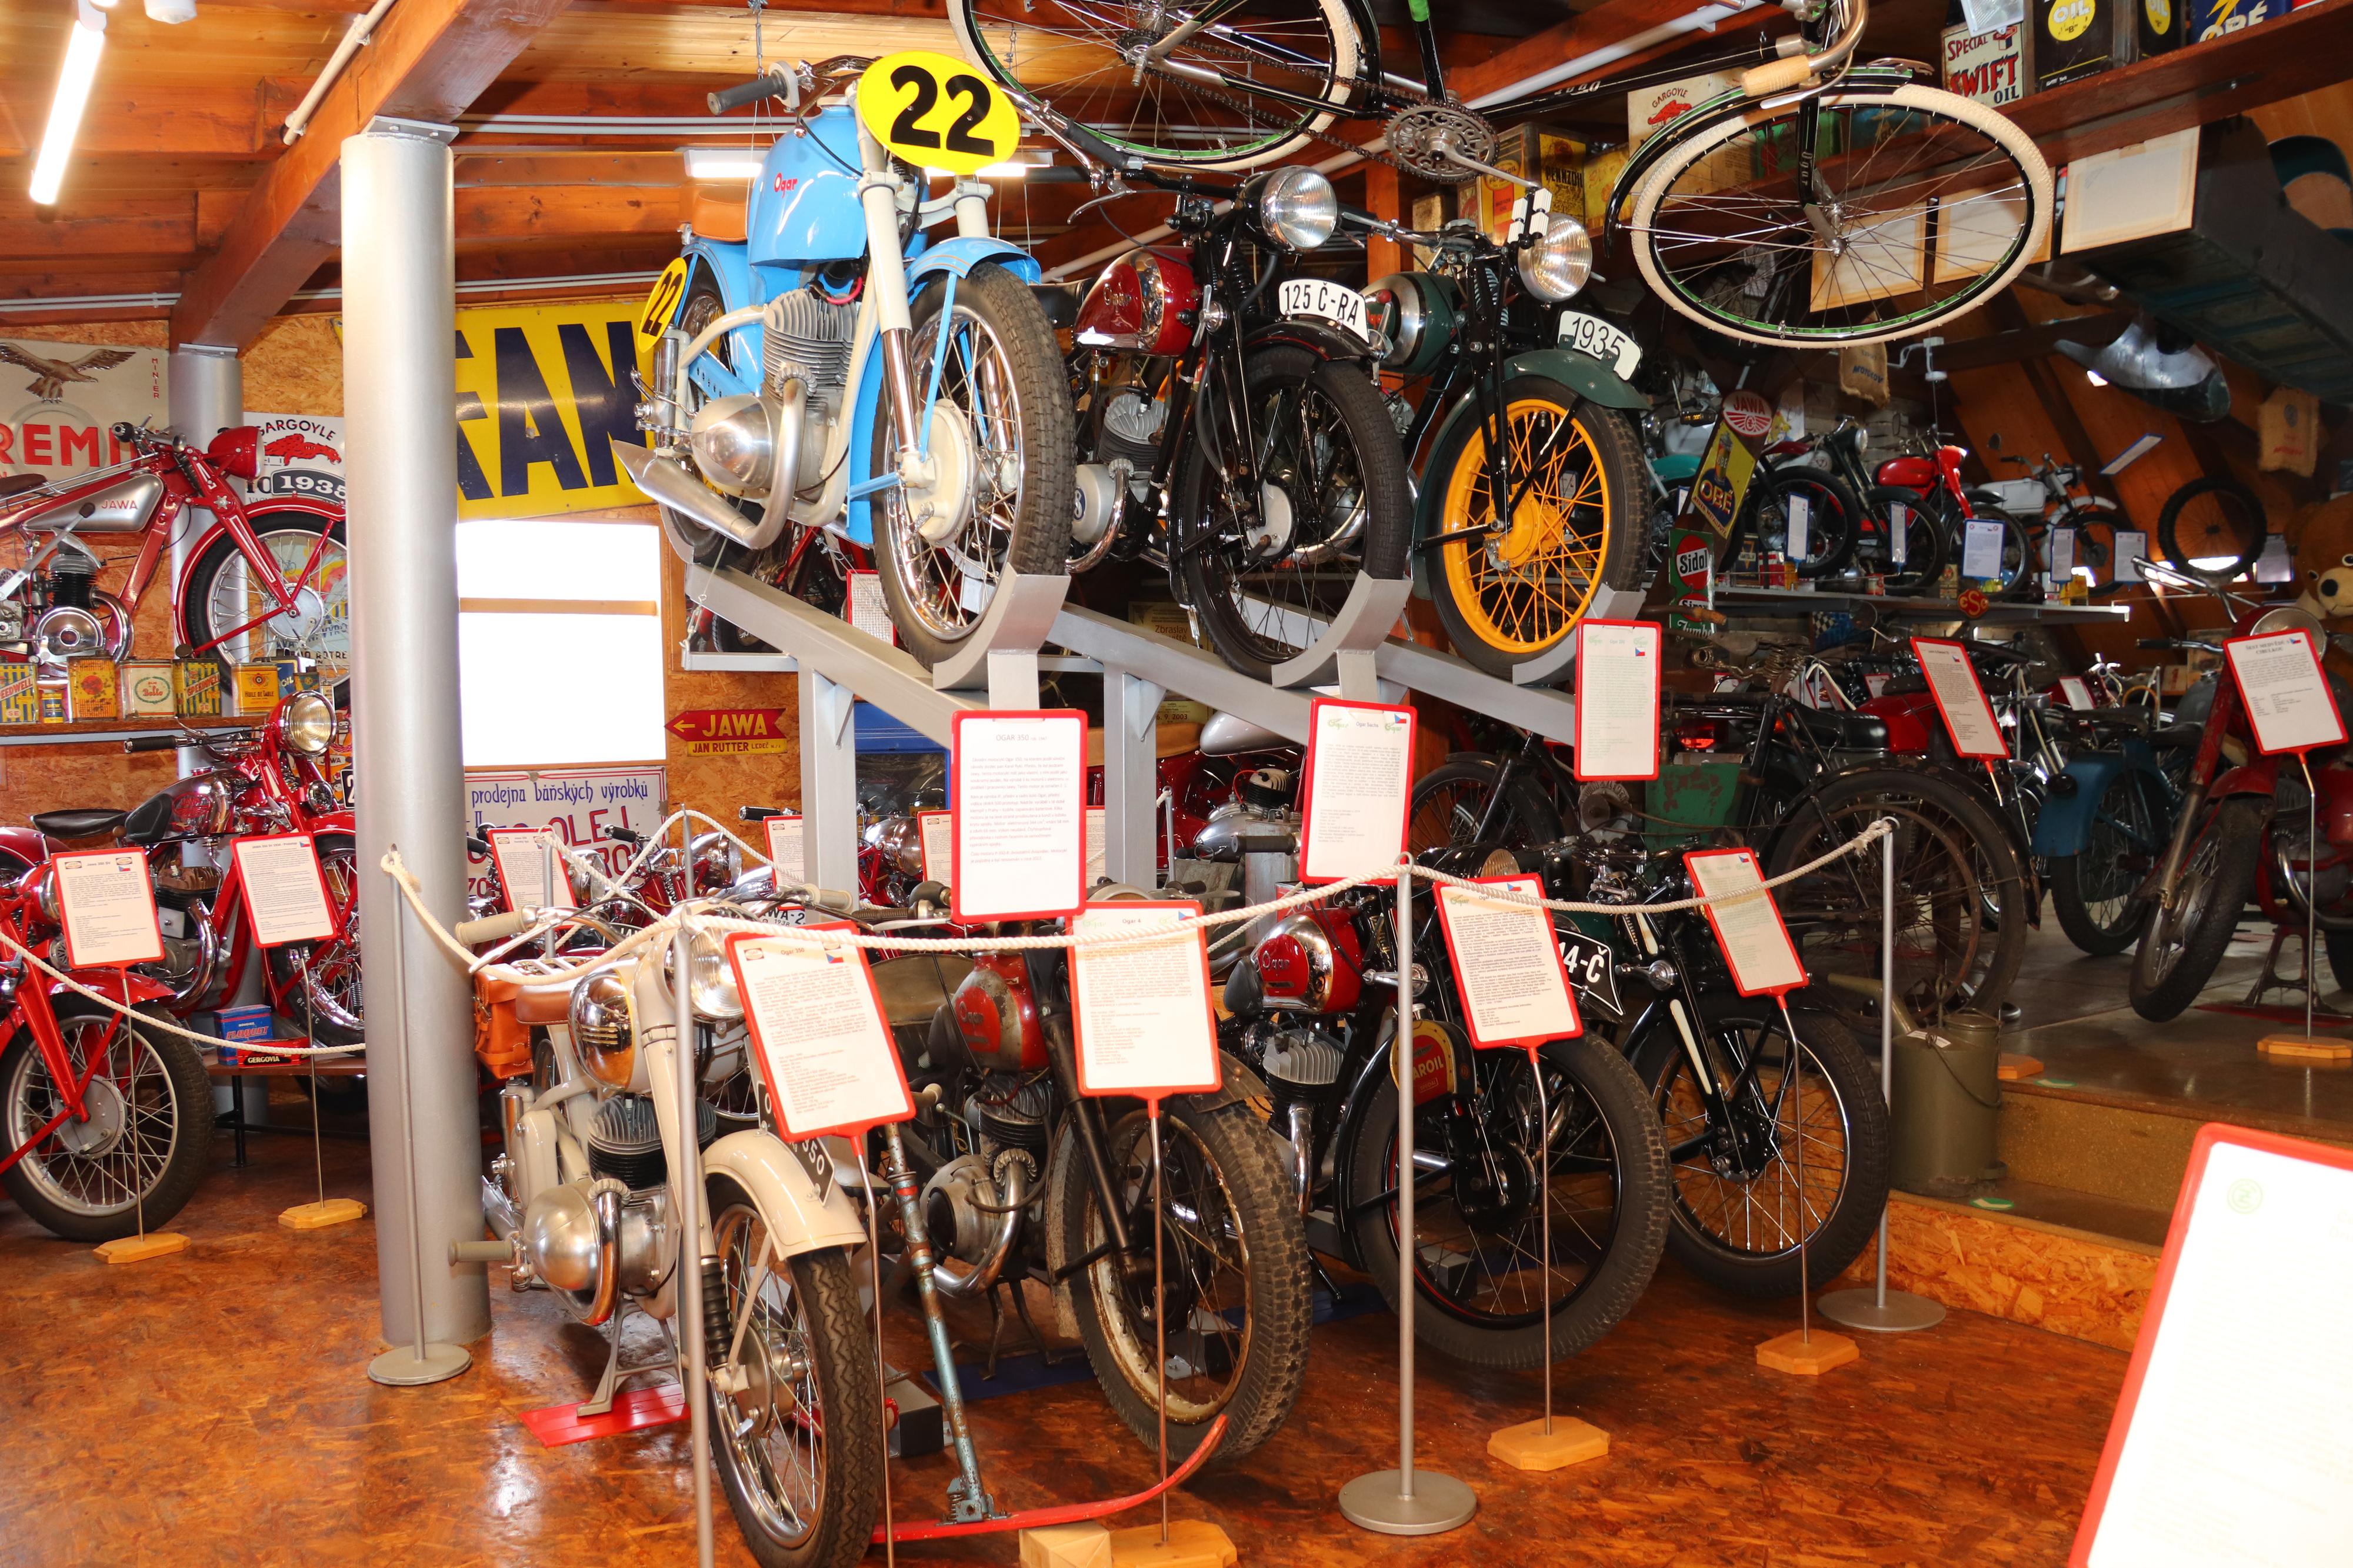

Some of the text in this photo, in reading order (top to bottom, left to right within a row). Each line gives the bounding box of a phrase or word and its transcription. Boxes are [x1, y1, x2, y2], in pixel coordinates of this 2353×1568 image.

[2053, 1, 2091, 24] OIL
[1948, 36, 1988, 61] SPECIAL
[1949, 51, 2019, 98] SWIFT
[1652, 87, 1688, 109] GARGOYLE
[1994, 86, 2019, 104] OIL
[890, 65, 995, 158] 22
[774, 172, 798, 199] Ogar
[1545, 165, 1582, 188] PENNZOIL
[641, 270, 680, 338] 22
[1285, 282, 1359, 326] 125 Č-RA
[1572, 316, 1626, 360] 1935
[151, 358, 160, 399] MINIER
[1853, 365, 1884, 383] MOTOKOV
[1732, 396, 1765, 415] JAWA
[280, 475, 346, 500] 1935
[101, 499, 138, 509] JAWA
[1679, 549, 1707, 574] Sidol
[1155, 625, 1188, 634] Zbraslav
[187, 673, 221, 697] SPEEDWELL
[702, 713, 768, 737] JAWA
[692, 743, 710, 753] JAN
[712, 742, 749, 752] RUTTER
[471, 783, 526, 809] prodejna
[601, 778, 648, 803] výrobků
[774, 919, 790, 927] 1938
[226, 1026, 269, 1040] FLOQUET
[1413, 1055, 1444, 1080] AROIL
